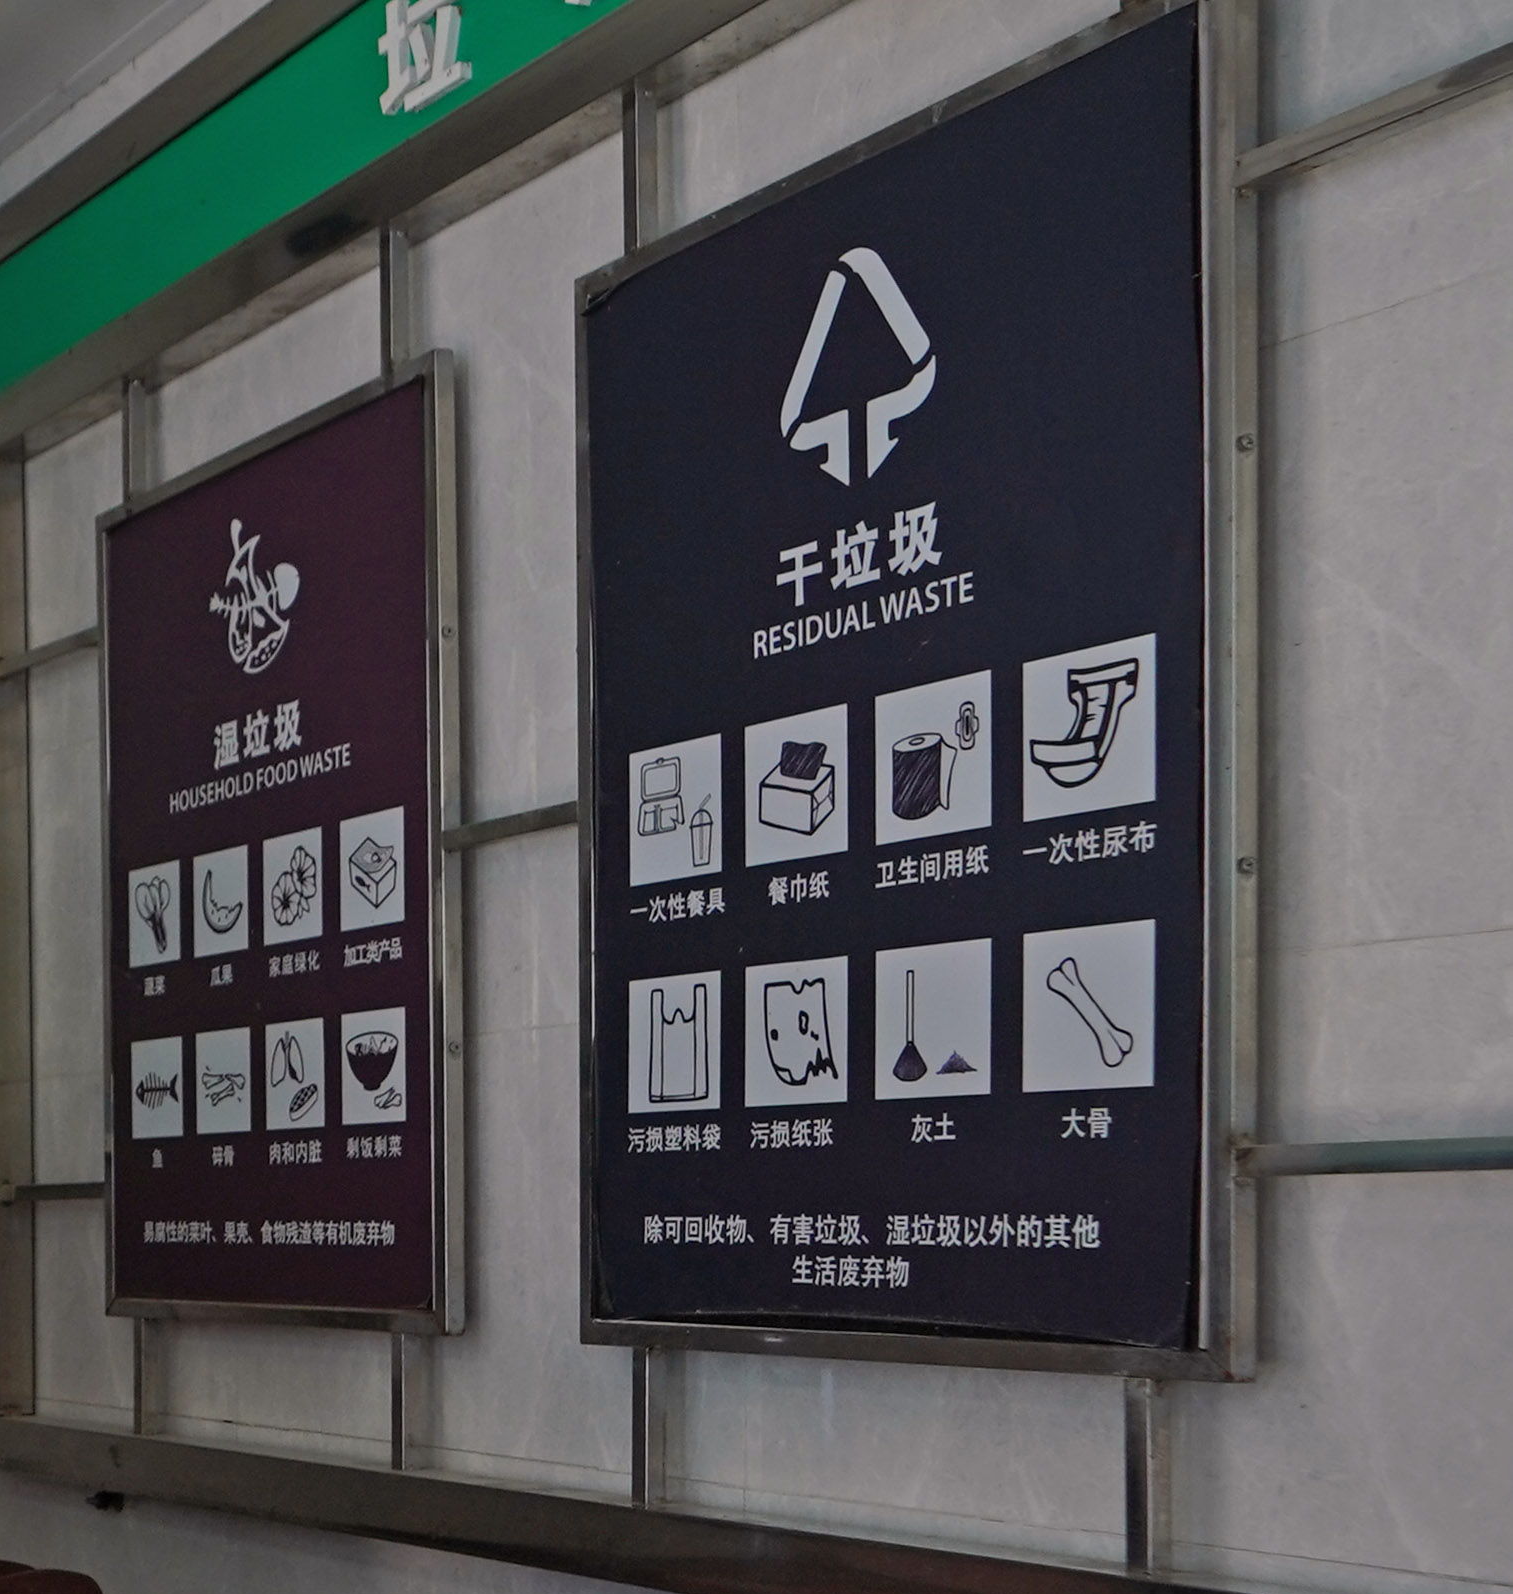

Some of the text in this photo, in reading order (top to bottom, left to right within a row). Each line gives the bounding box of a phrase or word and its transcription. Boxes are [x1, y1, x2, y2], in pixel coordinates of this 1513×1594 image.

[776, 501, 943, 607] 干垃圾
[753, 571, 974, 659] RESIDUAL WASTE
[214, 699, 302, 770] 湿垃圾
[169, 742, 351, 814] HOUSEHOLD FOOD WASTE
[1022, 819, 1158, 865] 一次性尿布
[875, 844, 990, 889] 卫生间用纸
[629, 887, 726, 924] 一次性餐具
[767, 871, 830, 907] 餐巾纸
[268, 950, 321, 978] 家庭绿化
[343, 937, 403, 967] 加工类产品
[210, 964, 234, 986] 瓜果
[628, 1123, 721, 1154] 污损塑料袋
[750, 1118, 834, 1149] 污损纸张
[910, 1113, 957, 1143] 灰土
[1060, 1107, 1112, 1139] 大骨
[152, 1146, 163, 1168] 鱼
[269, 1139, 323, 1165] 肉和内脏
[792, 1255, 910, 1289] 生活废弃物
